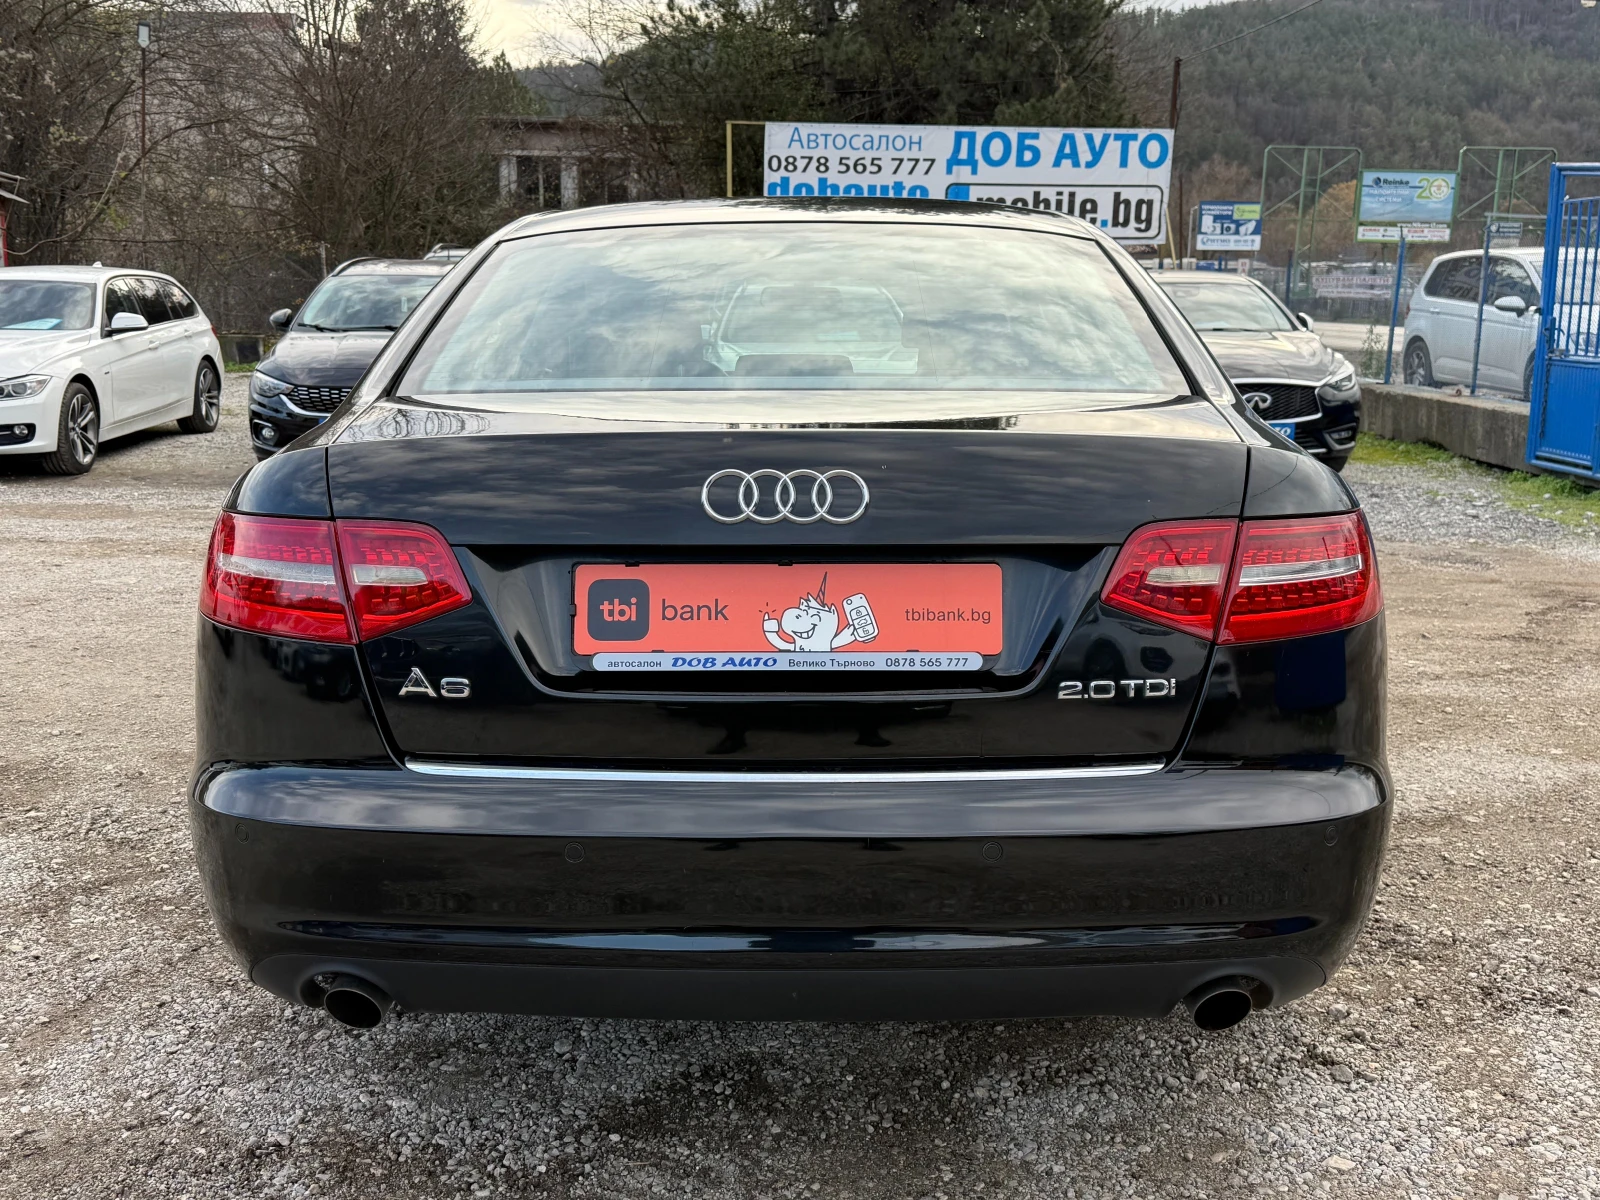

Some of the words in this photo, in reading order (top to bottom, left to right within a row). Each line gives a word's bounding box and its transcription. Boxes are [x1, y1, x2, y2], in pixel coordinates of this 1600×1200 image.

[788, 126, 922, 151] Автосалон
[945, 131, 1041, 175] ДОБ
[1052, 133, 1169, 169] АУТО
[767, 155, 830, 173] 0878
[837, 157, 882, 174] 565
[891, 158, 936, 175] 777
[1382, 178, 1410, 187] Reinke
[600, 597, 637, 622] tbi
[661, 599, 729, 621] bank
[905, 608, 991, 624] tbibank.bg
[607, 660, 662, 668] автосалон
[671, 657, 717, 669] DOB
[721, 657, 778, 668] AUTO
[788, 658, 827, 668] Велико
[829, 658, 875, 669] Търново
[885, 658, 916, 667] 0878
[919, 658, 942, 667] 565
[946, 658, 969, 667] 777
[398, 667, 470, 698] A6
[1057, 680, 1116, 699] 2.0
[1120, 678, 1176, 697] TDI
